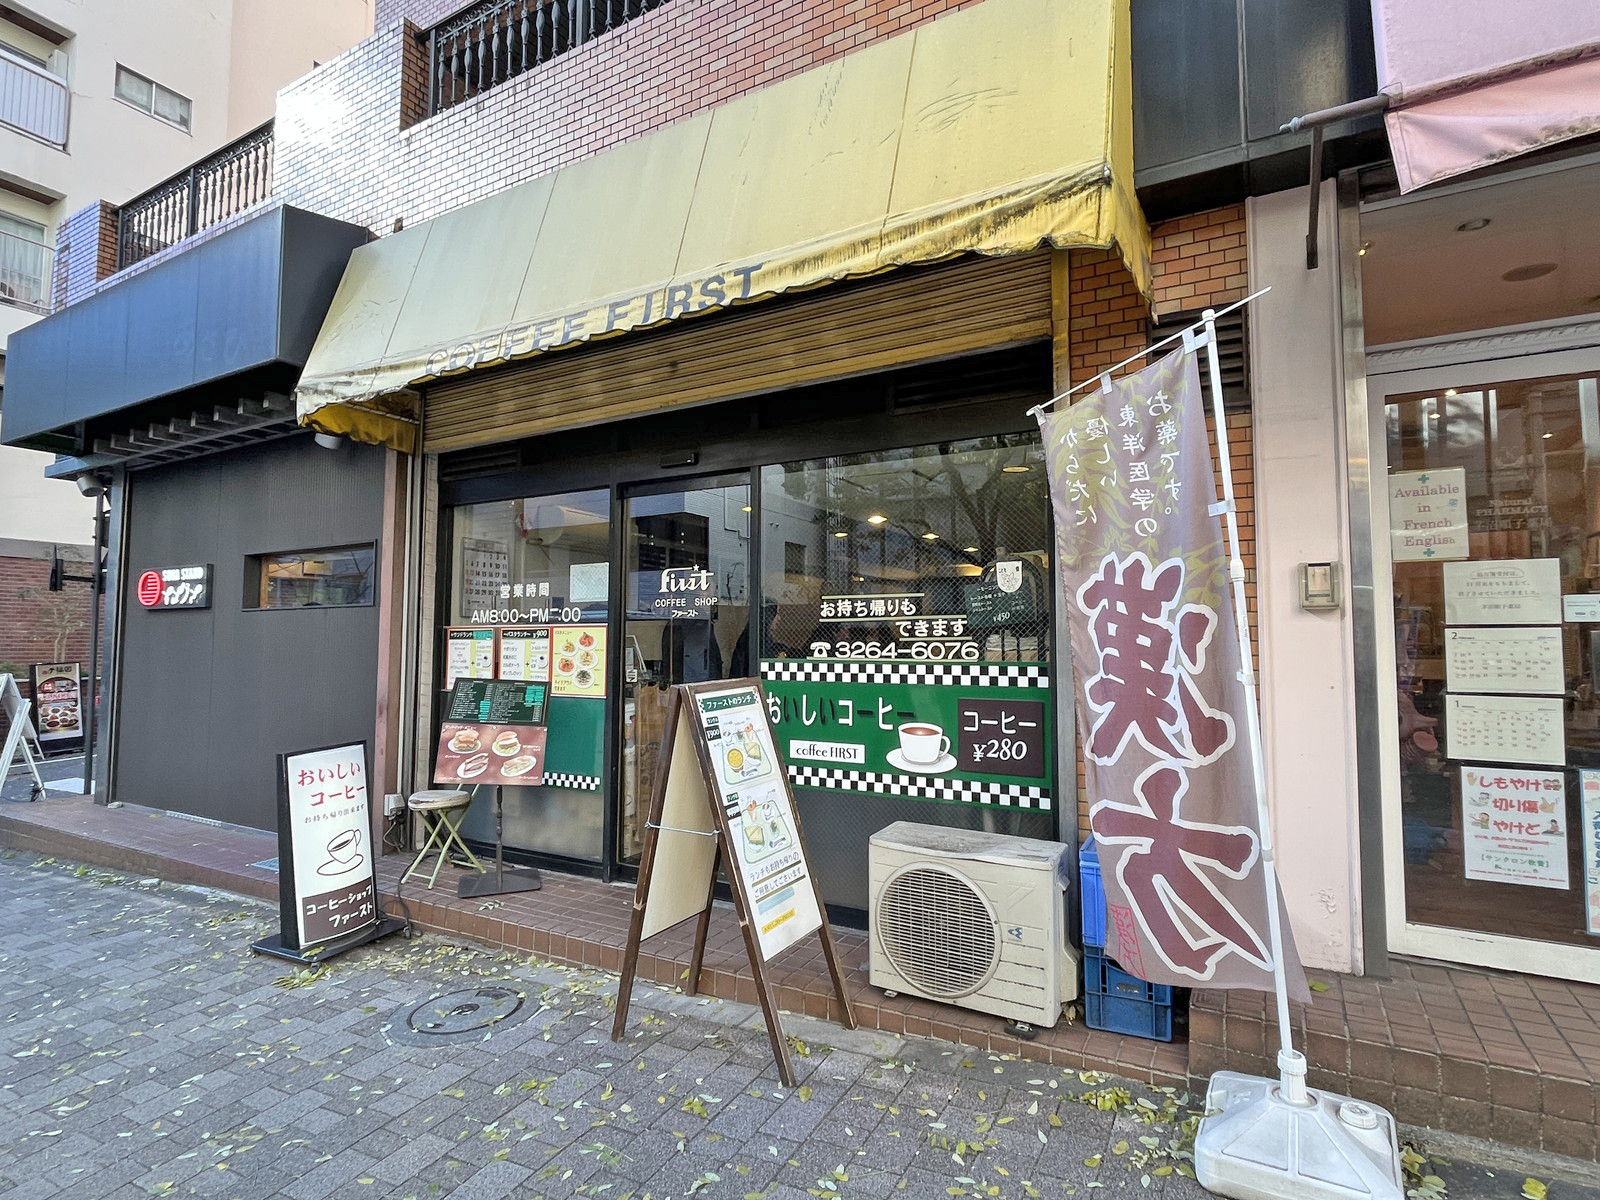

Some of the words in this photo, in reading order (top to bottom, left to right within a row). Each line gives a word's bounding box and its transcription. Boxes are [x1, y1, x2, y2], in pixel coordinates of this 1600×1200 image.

[424, 310, 589, 377] COFFEE
[605, 263, 766, 333] FIRST
[1394, 484, 1460, 499] Available
[1417, 504, 1432, 513] in
[1475, 505, 1549, 517] PHARMACY
[1403, 518, 1452, 531] French
[1404, 535, 1456, 547] English
[500, 582, 550, 599] 営業時間
[654, 598, 687, 608] COFFEE
[694, 597, 718, 606] SHOP
[819, 599, 917, 618] お持ち帰りも
[671, 608, 699, 618] ファースト
[532, 630, 548, 639] ¥900
[895, 619, 968, 637] できます
[1451, 632, 1458, 640] 2
[835, 641, 980, 660] 3264-6076
[706, 695, 752, 709] ファーストのランチ
[766, 690, 917, 731] おいしいコーヒー
[1455, 700, 1460, 708] 1
[963, 710, 1037, 735] コーヒー
[706, 729, 720, 740] ¥900
[796, 744, 828, 757] coffee
[830, 747, 859, 760] FIRST
[972, 740, 1028, 762] ¥280
[297, 762, 361, 787] おいしい
[1479, 775, 1542, 792] しもやけ
[310, 784, 365, 807] コーヒー
[1492, 797, 1540, 814] 切り傷
[1493, 820, 1541, 836] やけど
[750, 851, 800, 882] ランチもお持ち帰りの
[306, 884, 373, 916] コーヒーショップ
[328, 902, 373, 928] ファースト
